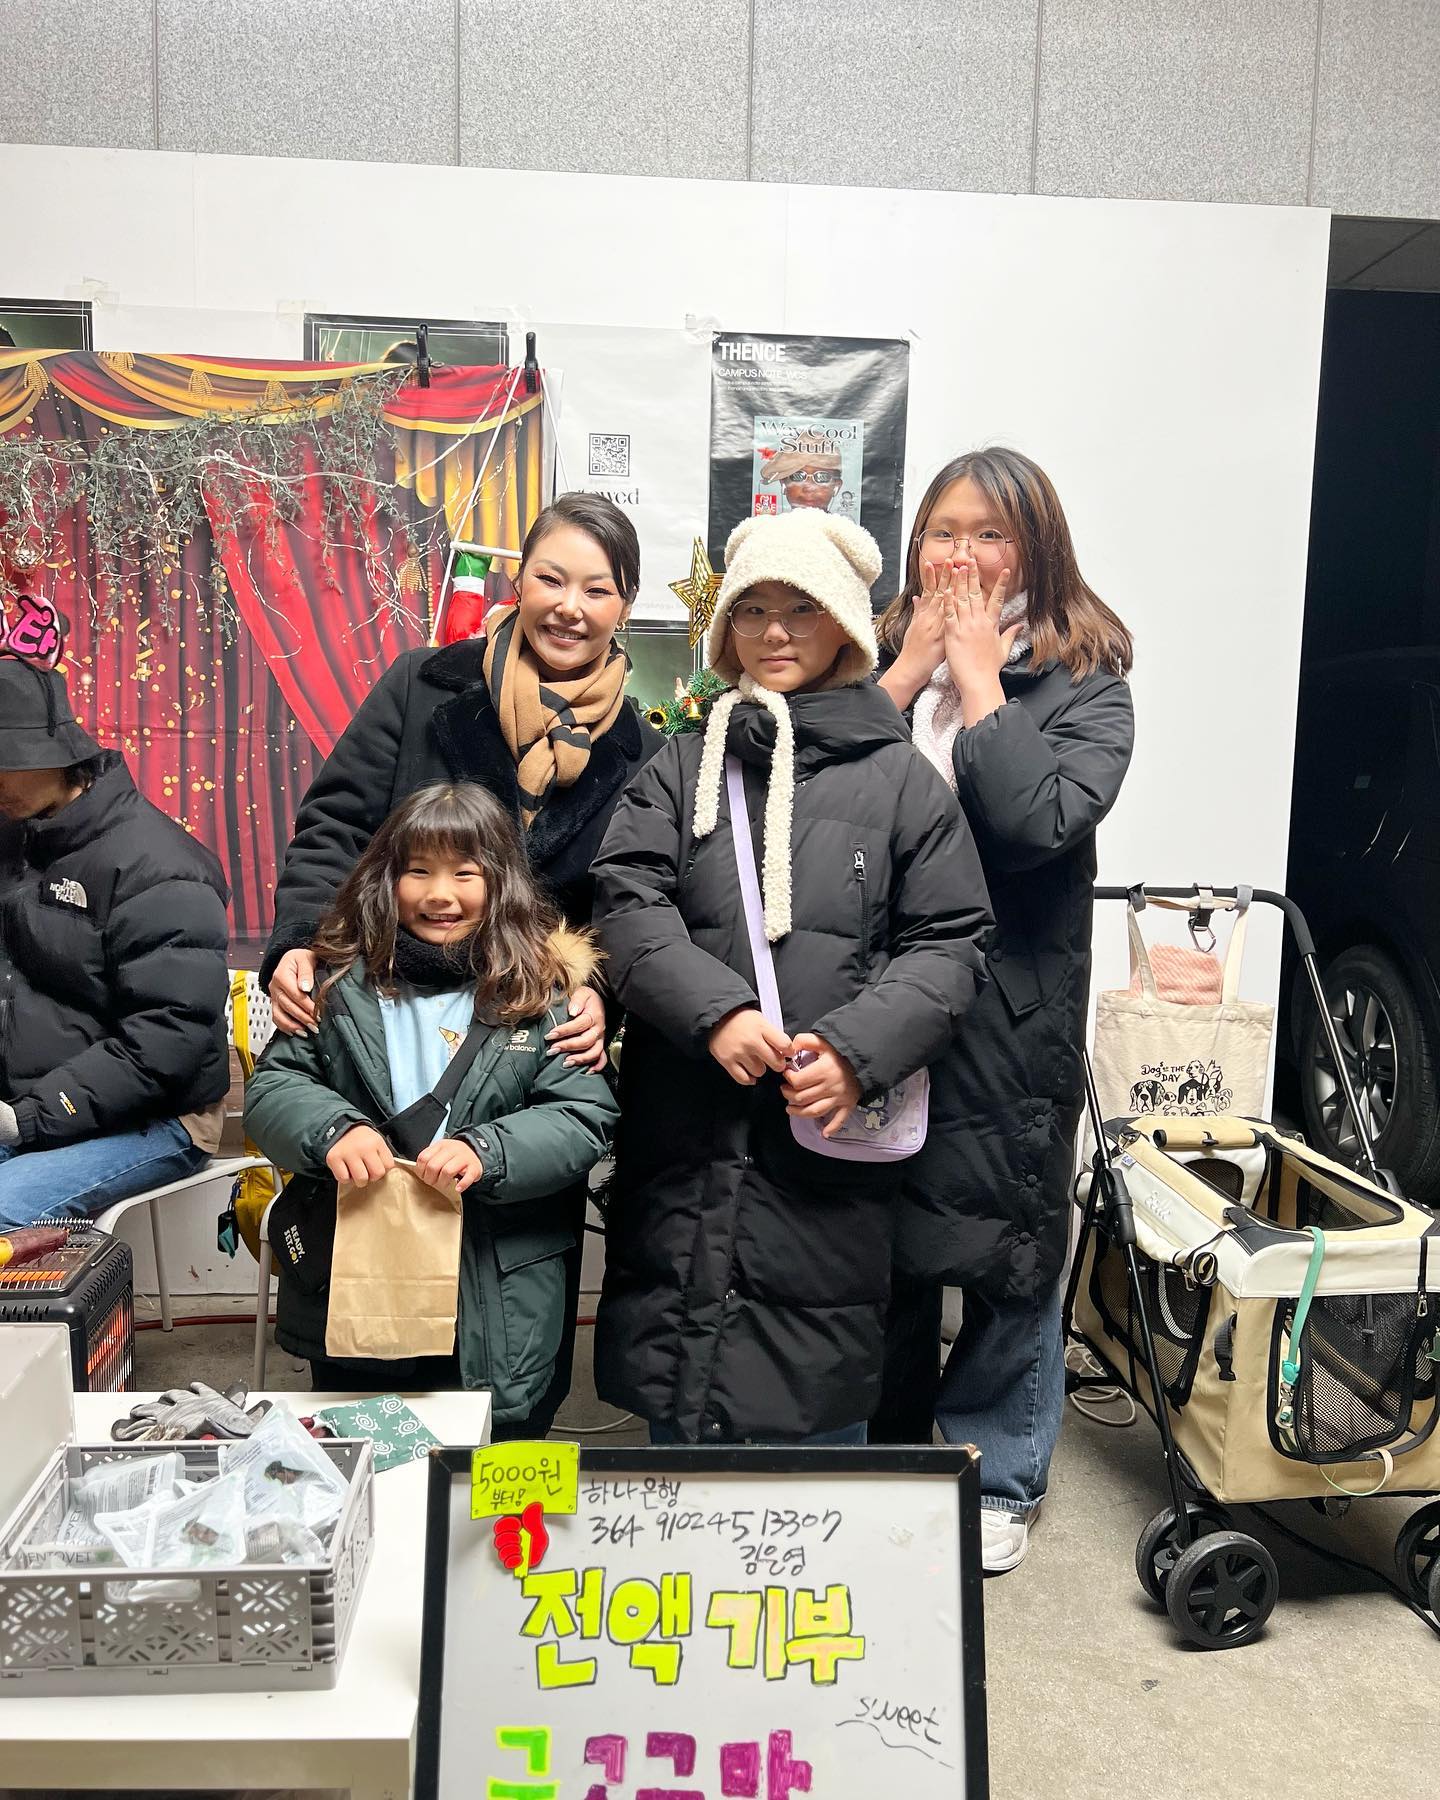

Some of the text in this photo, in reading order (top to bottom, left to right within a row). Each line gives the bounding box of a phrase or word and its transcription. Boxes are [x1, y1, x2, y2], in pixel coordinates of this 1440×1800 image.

[719, 342, 786, 362] THENCE
[718, 368, 757, 378] CAMPUS
[761, 421, 858, 442] Way Cool
[780, 437, 842, 455] Stuff
[50, 882, 76, 897] NORTH
[62, 877, 75, 889] THE
[56, 890, 75, 903] FACE
[510, 1044, 537, 1052] balance
[1170, 1065, 1186, 1073] THE
[1161, 1073, 1181, 1083] DAY
[480, 1457, 563, 1496] 5000원
[490, 1488, 526, 1511] 부터!
[18, 1550, 92, 1564] ENTOVET
[739, 1543, 806, 1577] 김은영
[520, 1567, 866, 1690] 전액 기부
